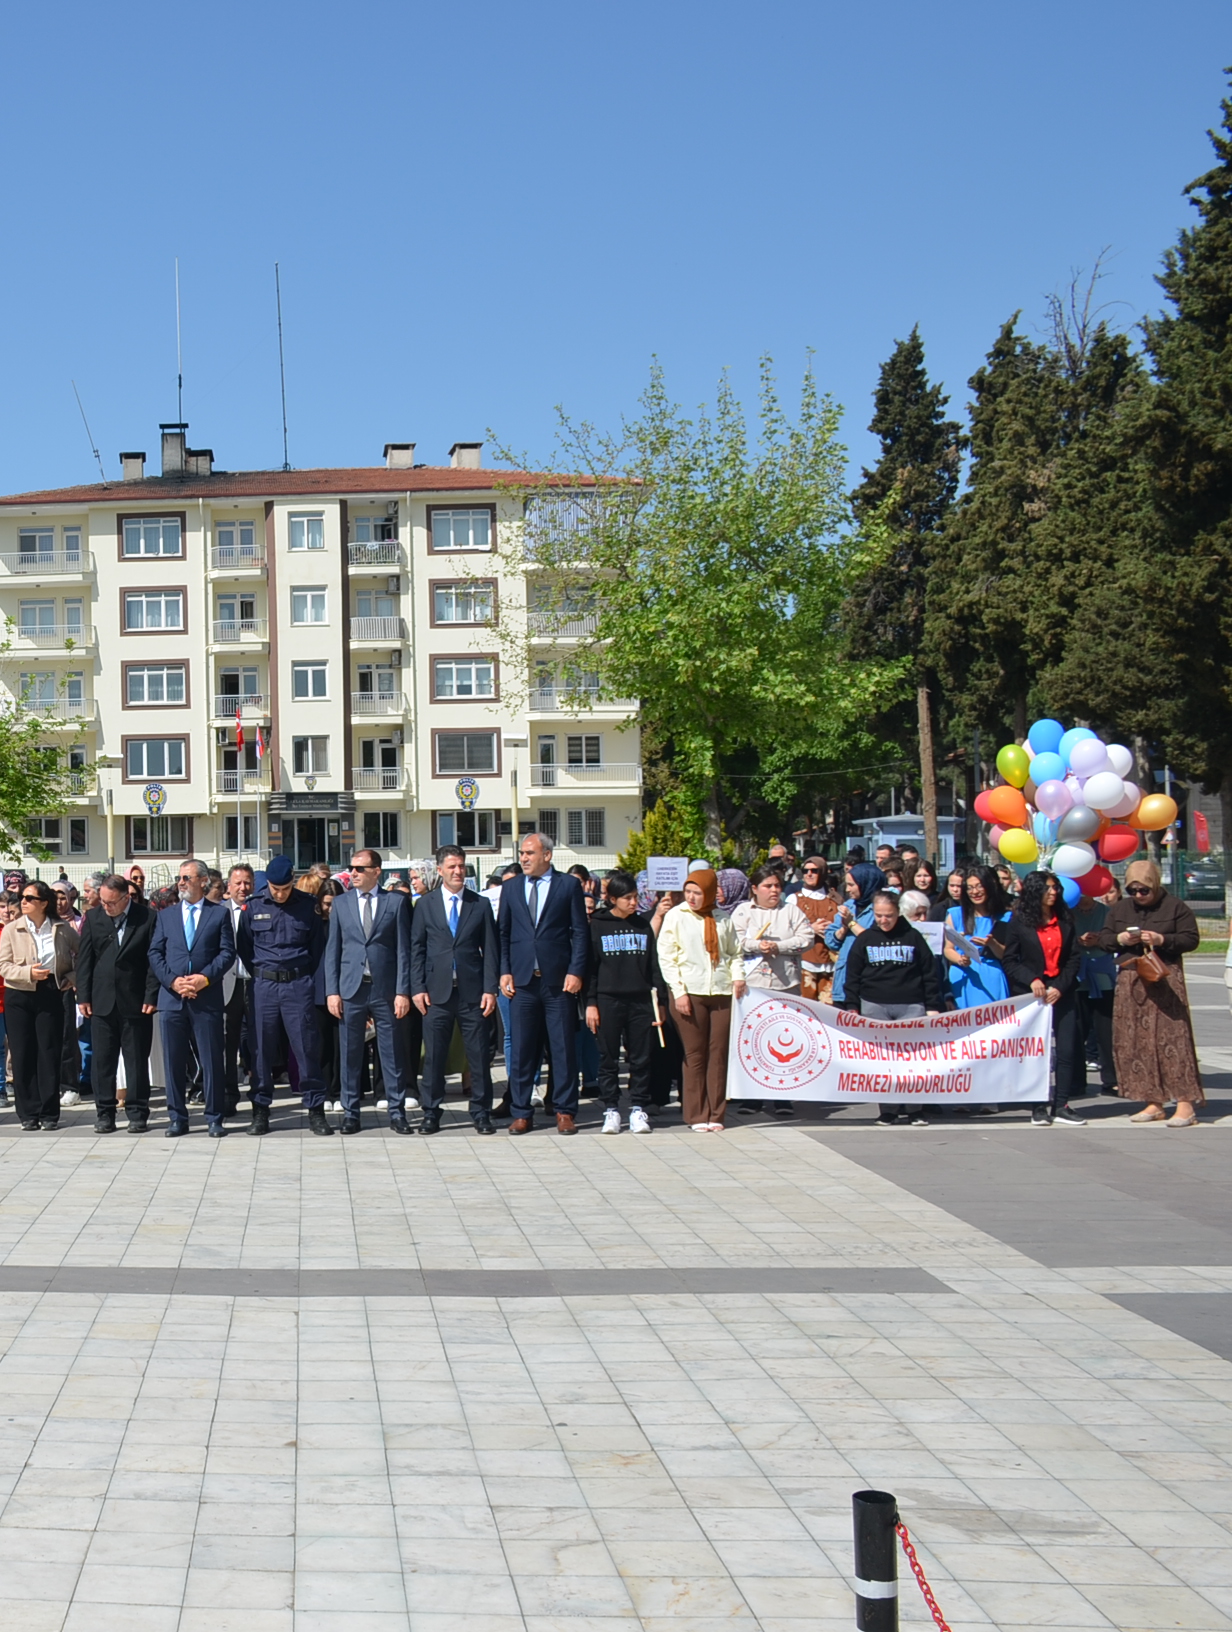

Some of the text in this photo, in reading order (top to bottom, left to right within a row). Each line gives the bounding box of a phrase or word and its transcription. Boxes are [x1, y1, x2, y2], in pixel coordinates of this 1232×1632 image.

[601, 934, 647, 952] BROOKLYN
[866, 945, 915, 963] BROOKLYN
[975, 1004, 1020, 1027] BAKIM,
[838, 1034, 1044, 1063] REHABİLİTASYON VE AİLE DANIŞMA
[838, 1068, 972, 1093] MERKEZİ MÜDÜRLÜĞÜ
